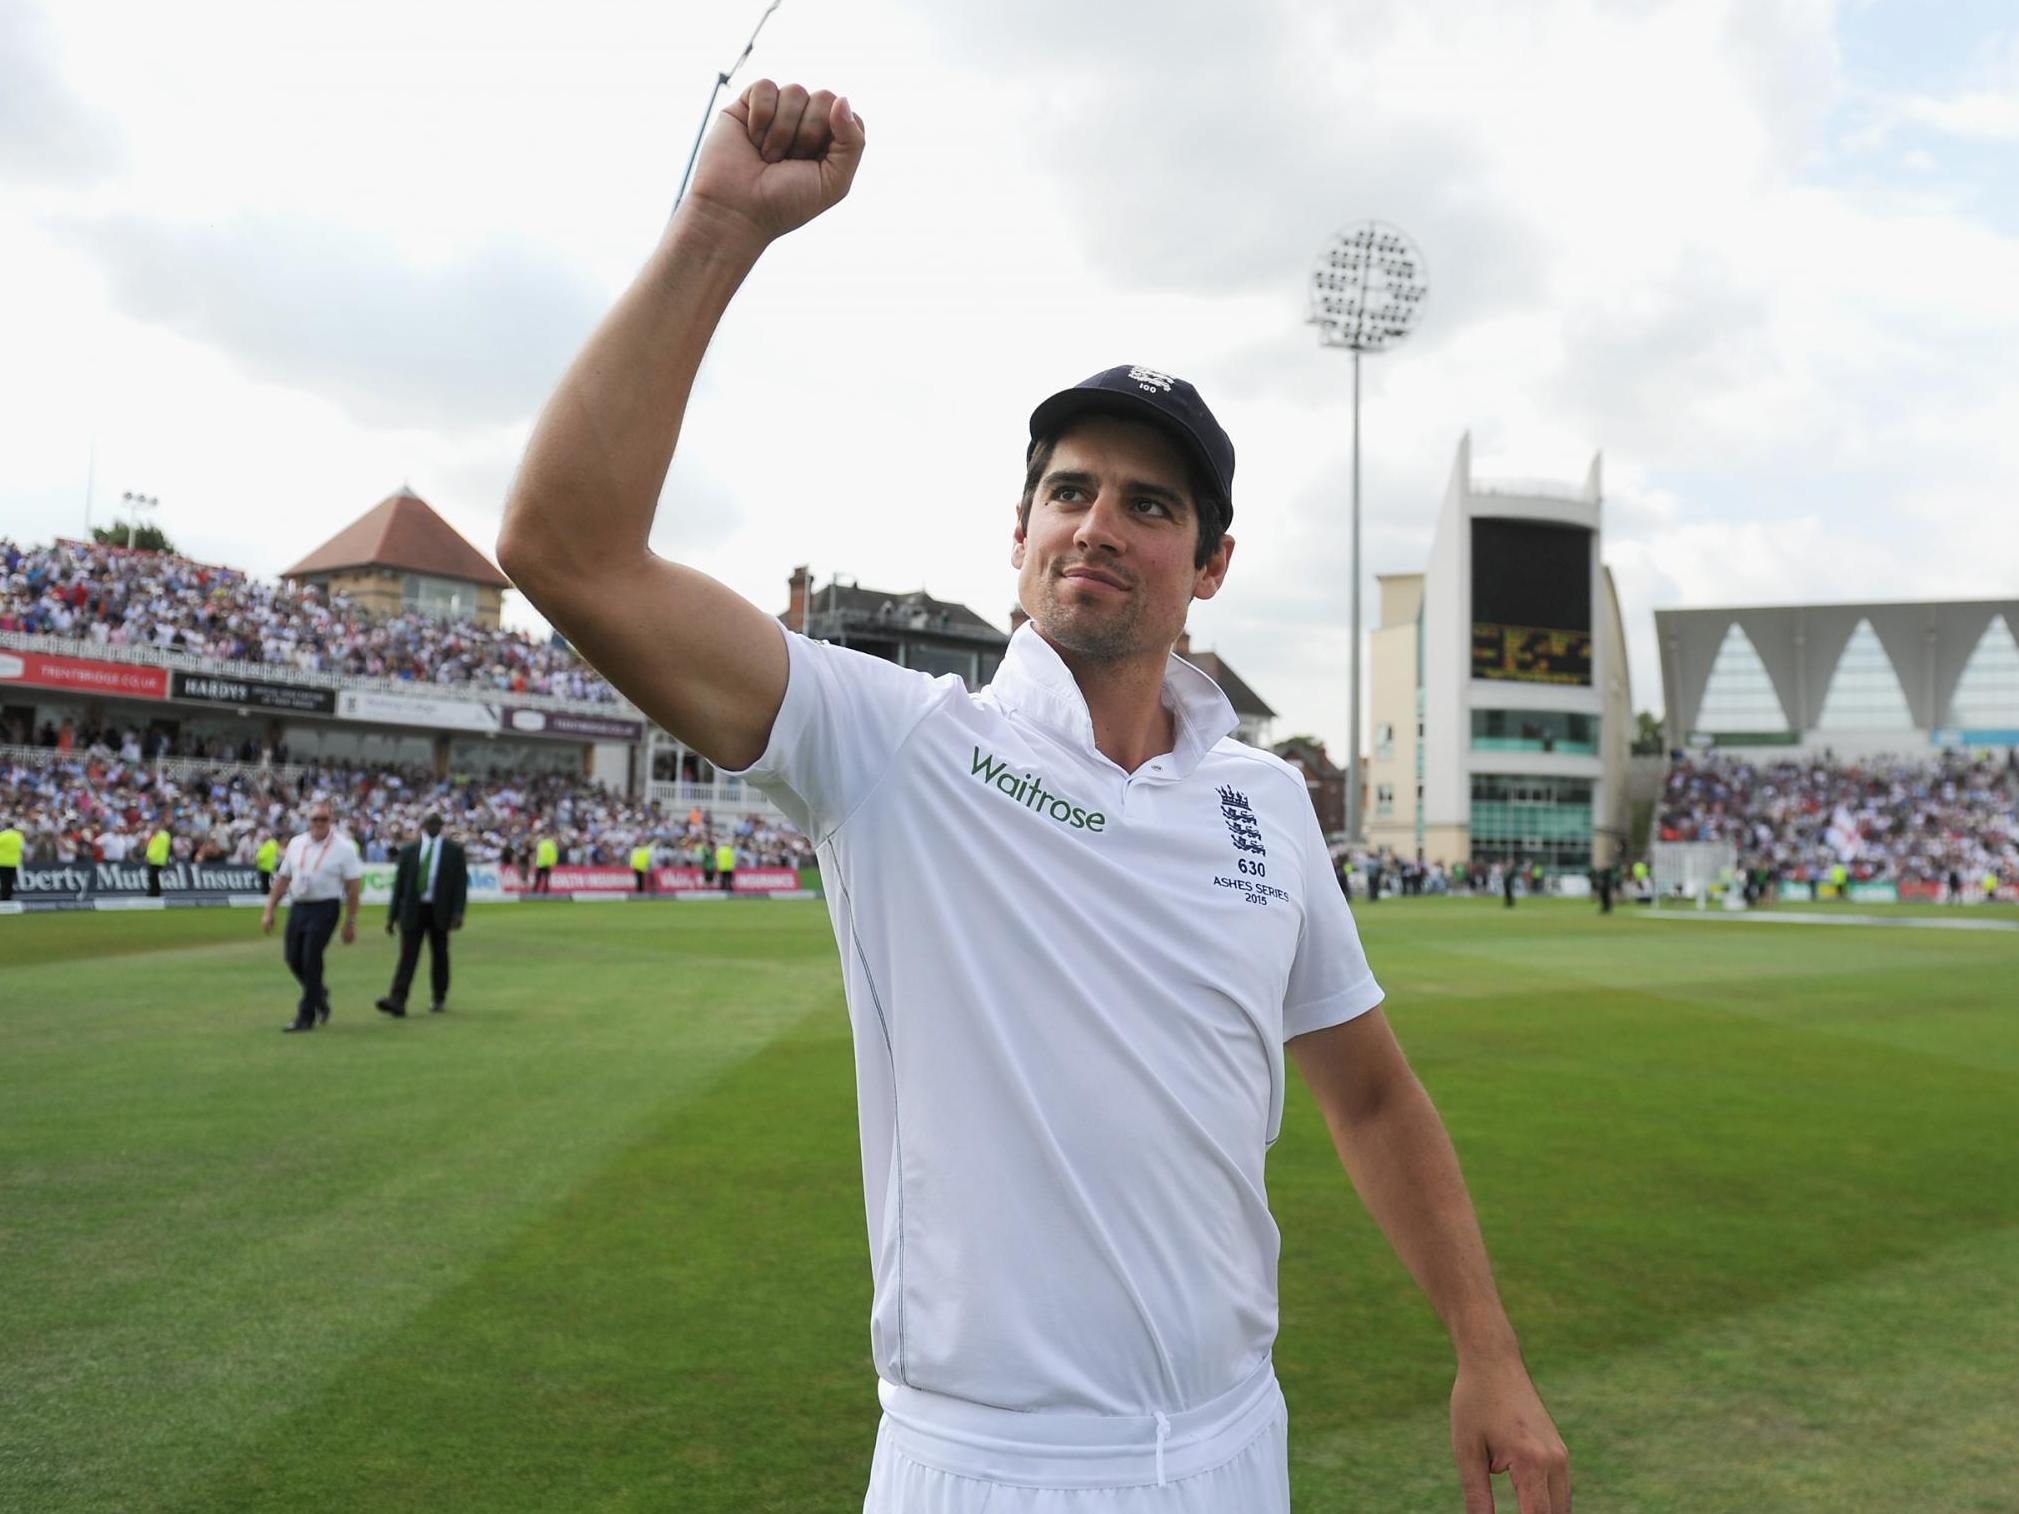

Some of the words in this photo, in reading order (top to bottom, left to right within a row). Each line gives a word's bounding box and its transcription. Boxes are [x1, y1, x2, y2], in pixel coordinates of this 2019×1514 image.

[185, 677, 248, 701] HARDYS
[971, 746, 1106, 832] Waitrose
[1238, 858, 1265, 877] 630
[13, 863, 90, 900] berty
[1213, 876, 1253, 892] ASHES
[1255, 883, 1289, 902] SERIES
[1245, 892, 1267, 906] 2015
